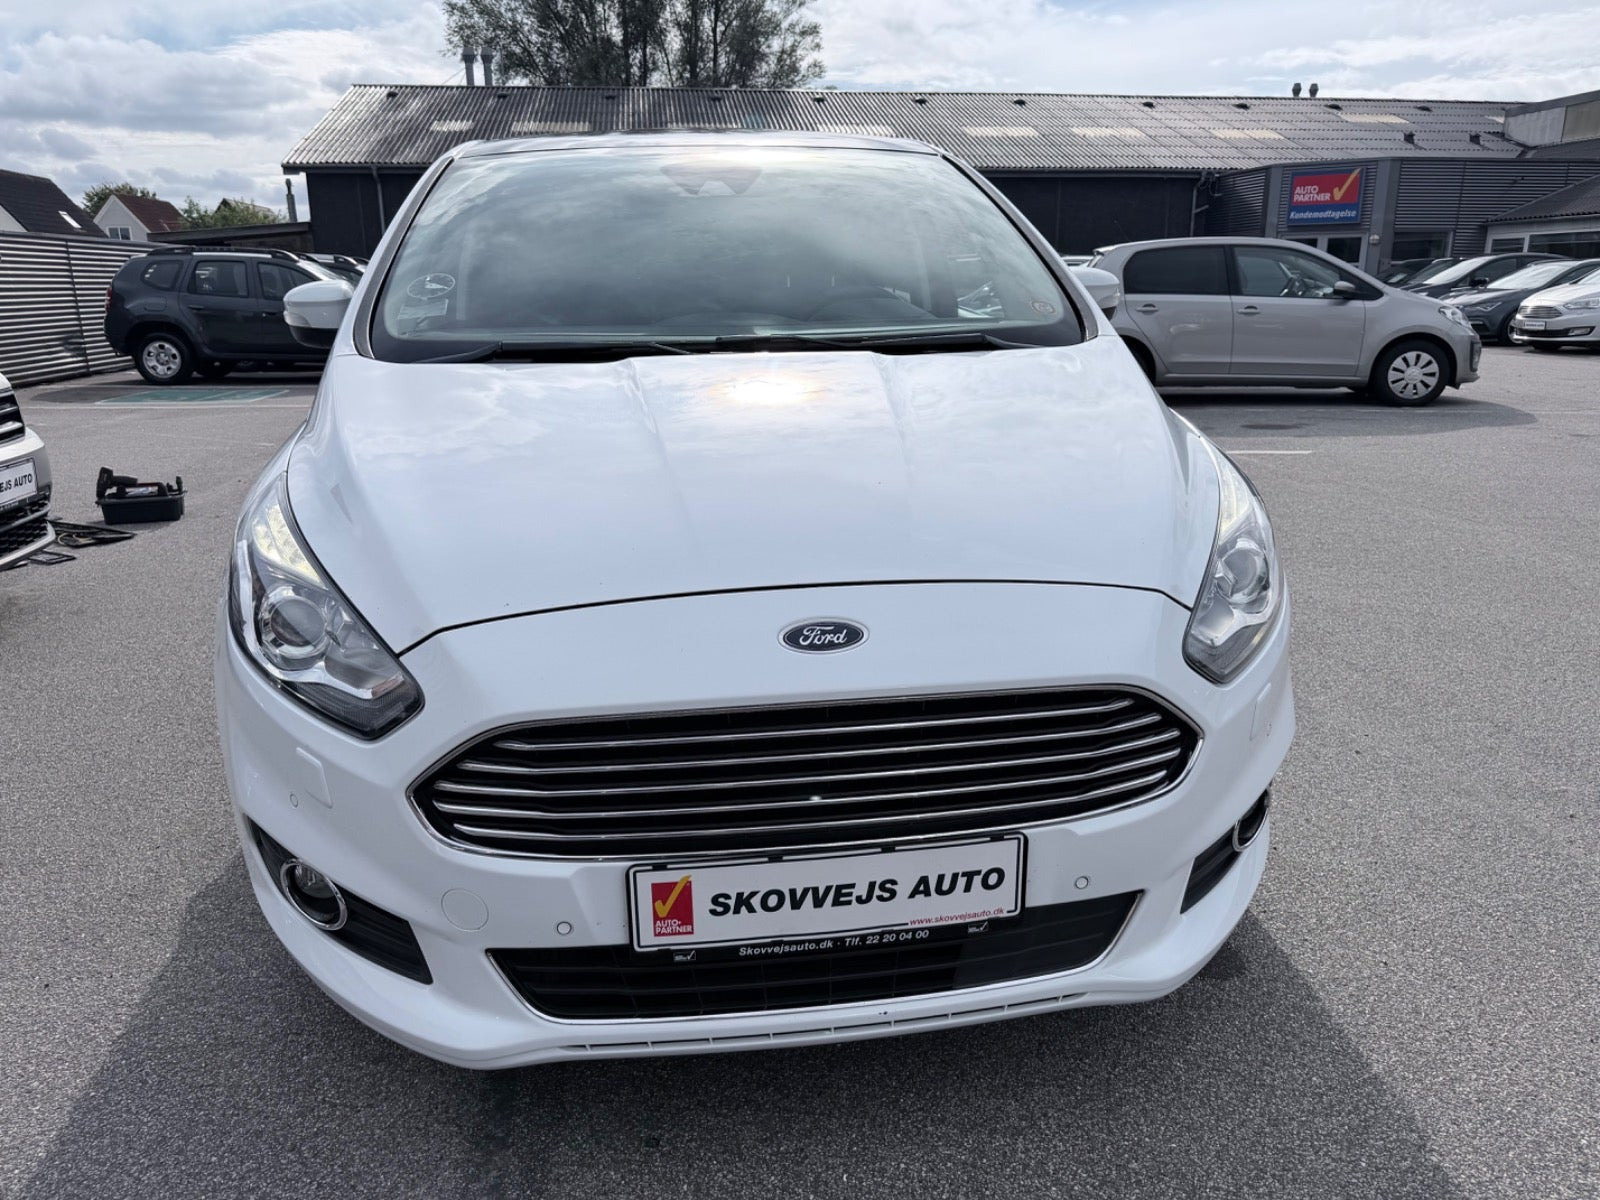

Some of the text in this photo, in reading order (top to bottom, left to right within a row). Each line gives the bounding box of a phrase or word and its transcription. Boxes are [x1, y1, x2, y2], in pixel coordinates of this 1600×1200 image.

[1294, 185, 1319, 194] AUTO
[1293, 193, 1331, 202] PARTNER
[1289, 209, 1357, 219] Kundemodtagelse
[14, 473, 33, 488] AUTO
[799, 625, 848, 646] Ford
[708, 866, 1006, 917] SKOVVEJS AUTO
[909, 907, 1004, 926] www.skovvejsauto.dk
[655, 925, 692, 934] PARTNER
[739, 940, 833, 956] Skovvejsauto.dk
[844, 937, 862, 947] Tlf.
[866, 936, 880, 945] 22
[883, 933, 897, 943] 20
[899, 931, 913, 942] 04
[915, 929, 930, 939] 00
